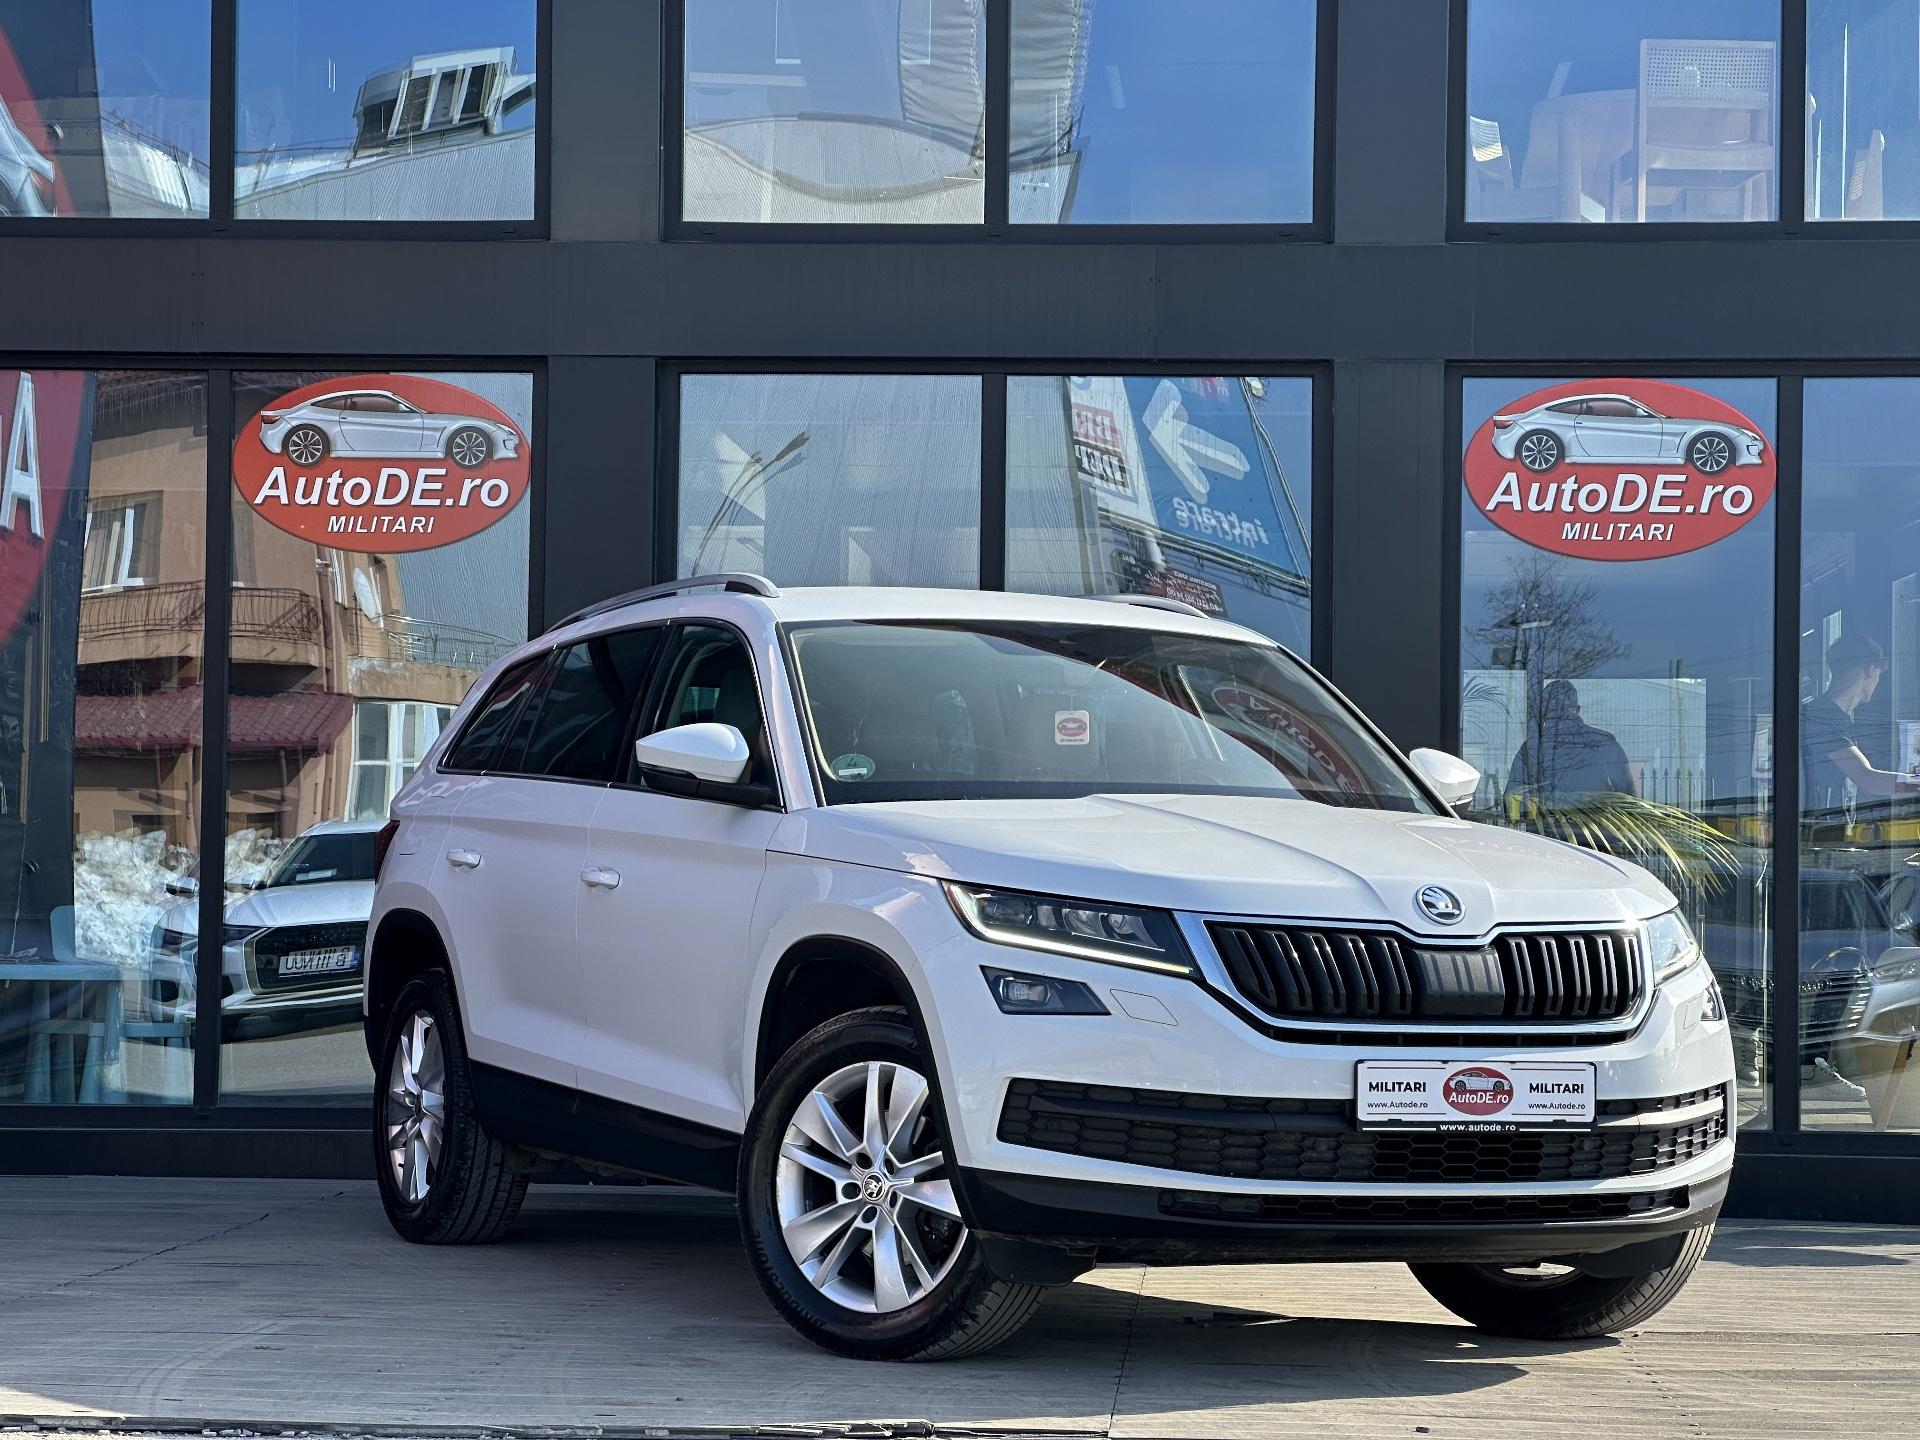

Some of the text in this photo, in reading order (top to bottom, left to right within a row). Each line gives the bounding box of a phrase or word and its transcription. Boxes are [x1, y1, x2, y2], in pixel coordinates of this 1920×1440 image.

[253, 466, 509, 508] AutoDE.ro
[1486, 471, 1753, 515] AutoDE.ro
[328, 516, 435, 533] MILITARI
[1561, 522, 1675, 541] MILITARI
[1368, 1081, 1427, 1093] MILITARI
[1529, 1082, 1584, 1094] MILITARI
[1367, 1100, 1428, 1108] www.Autode.ro
[1448, 1091, 1509, 1105] AutoDE.ro
[1528, 1102, 1586, 1110] www.Autode.ro
[1439, 1123, 1516, 1132] www.autode.ro
